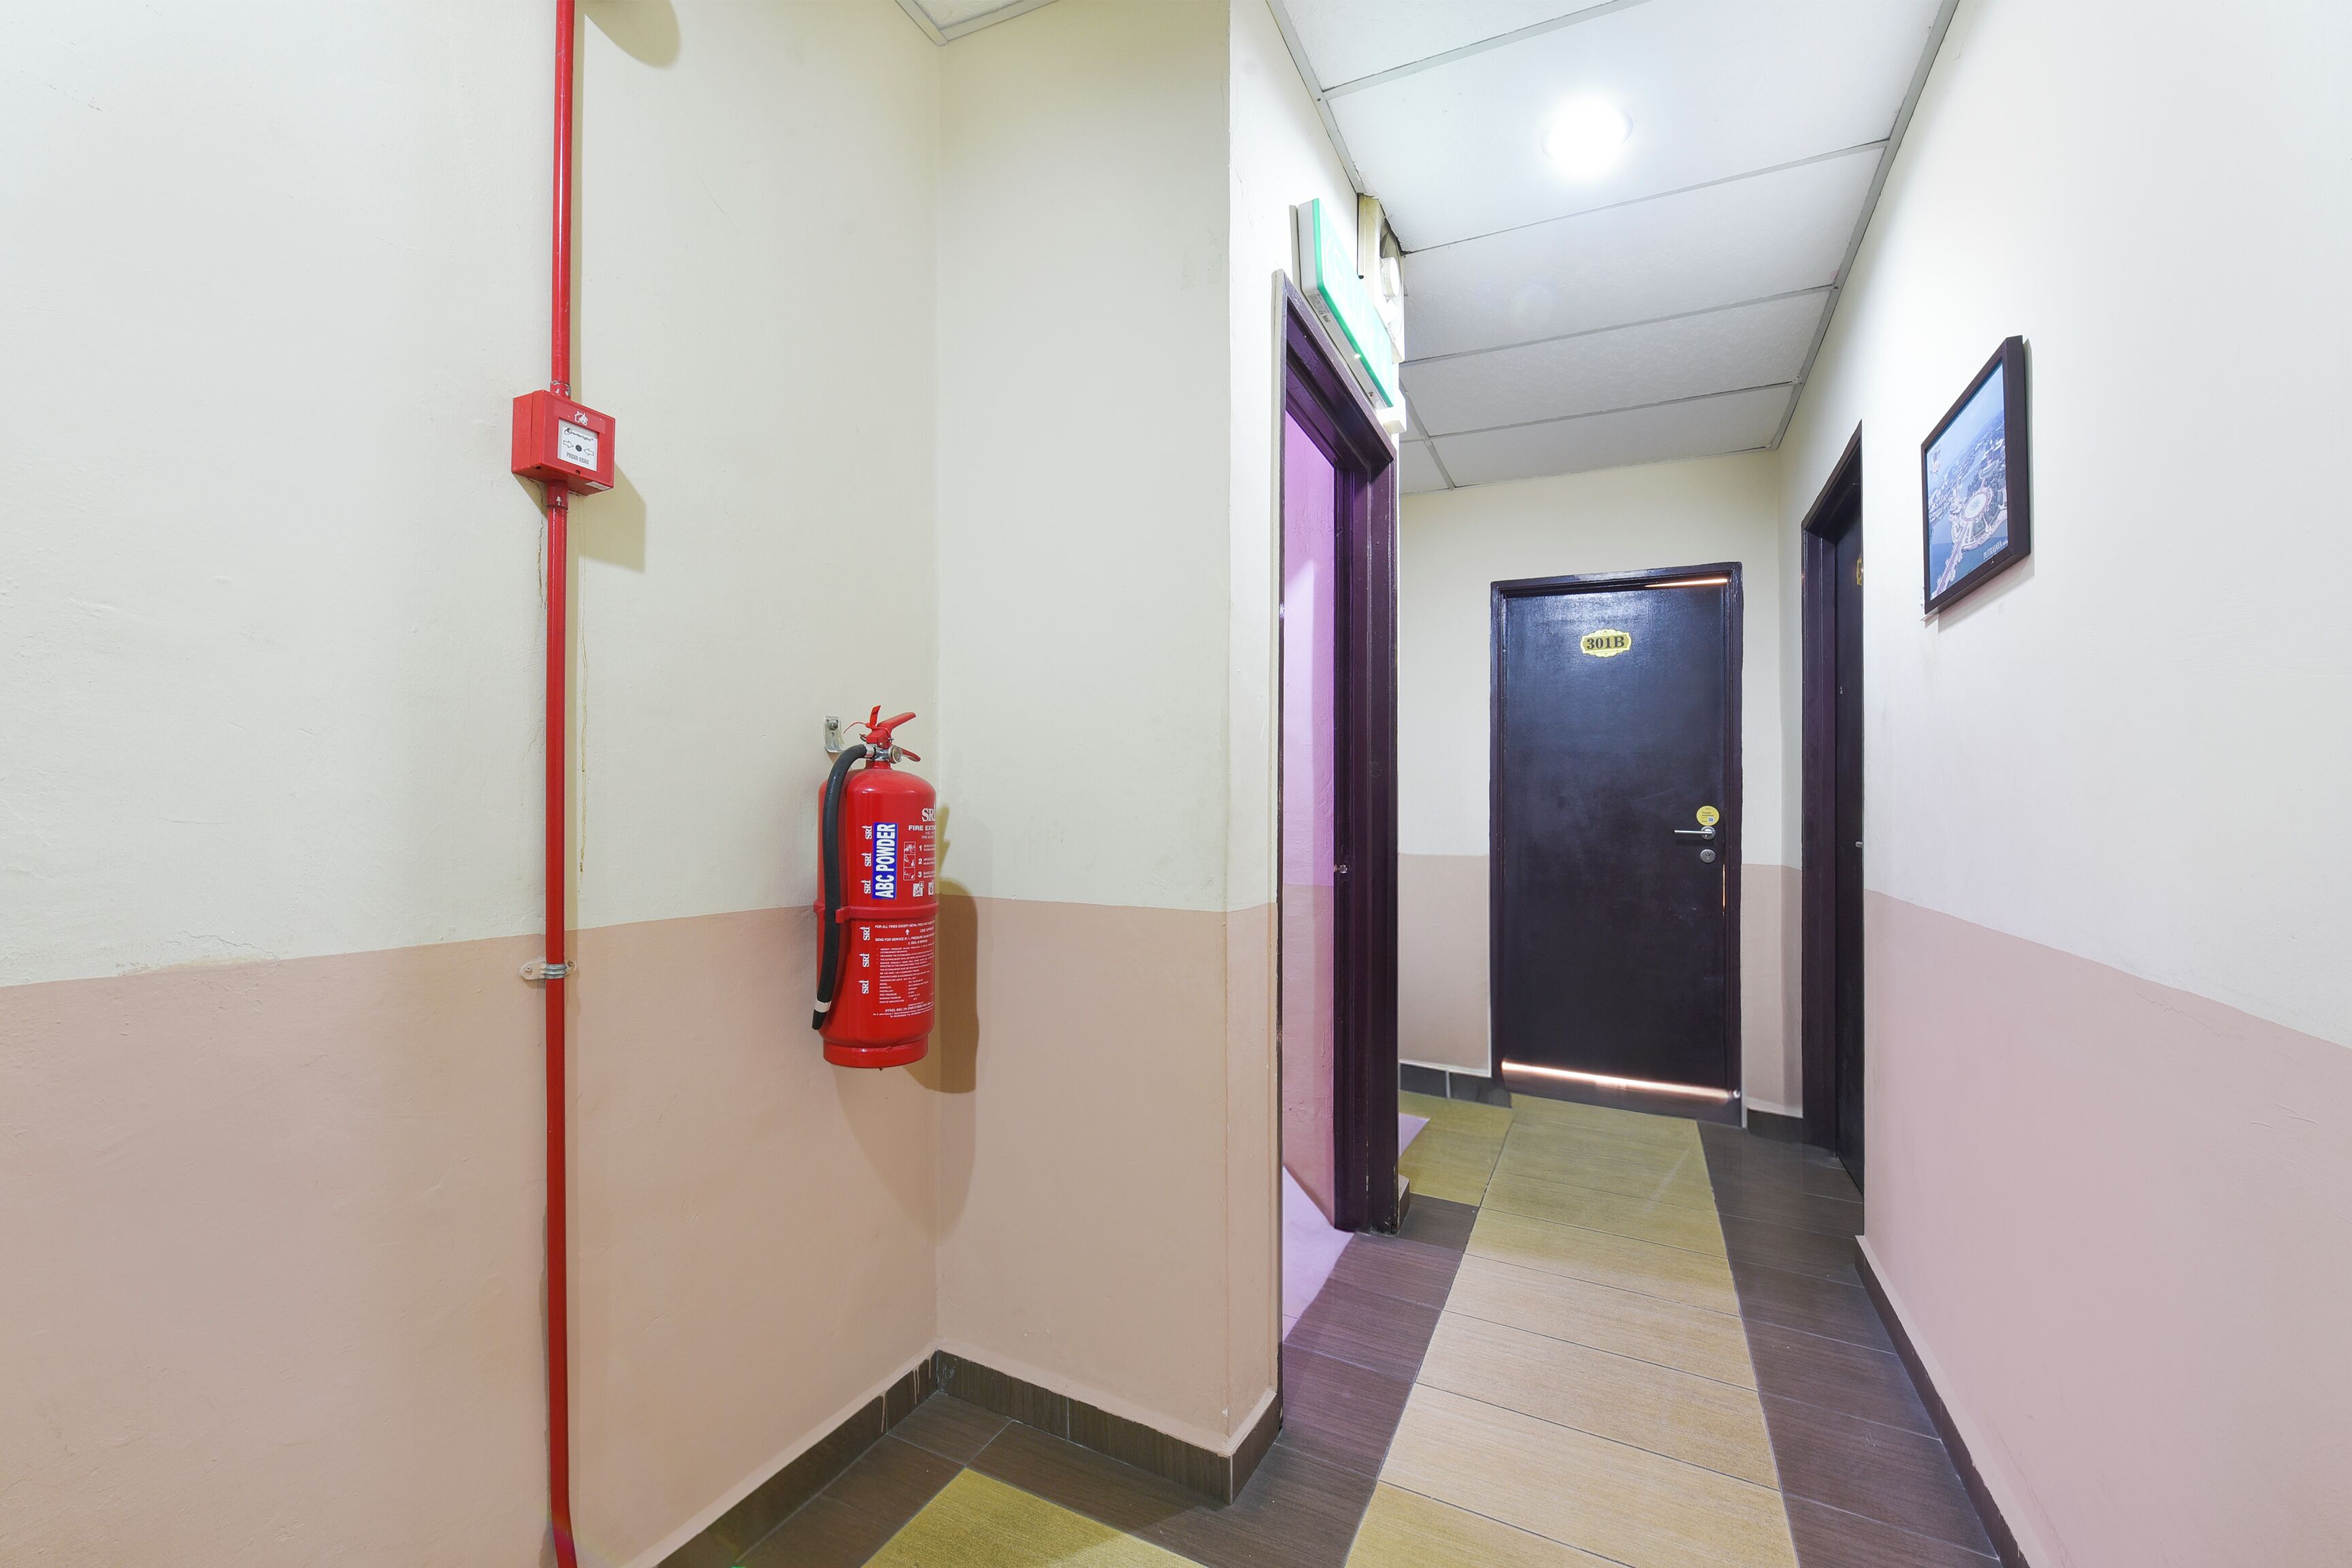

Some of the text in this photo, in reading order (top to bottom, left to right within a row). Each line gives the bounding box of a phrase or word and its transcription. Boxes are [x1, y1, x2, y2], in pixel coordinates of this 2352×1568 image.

[566, 452, 589, 465] PRESS HERE
[1586, 636, 1624, 649] 301B
[862, 826, 872, 840] SRI
[862, 853, 871, 867] SRI
[875, 823, 896, 898] ABC POWDER
[861, 880, 870, 894] SRI
[860, 926, 870, 941] SRI
[860, 953, 869, 968] SRI
[859, 980, 868, 994] SRI
